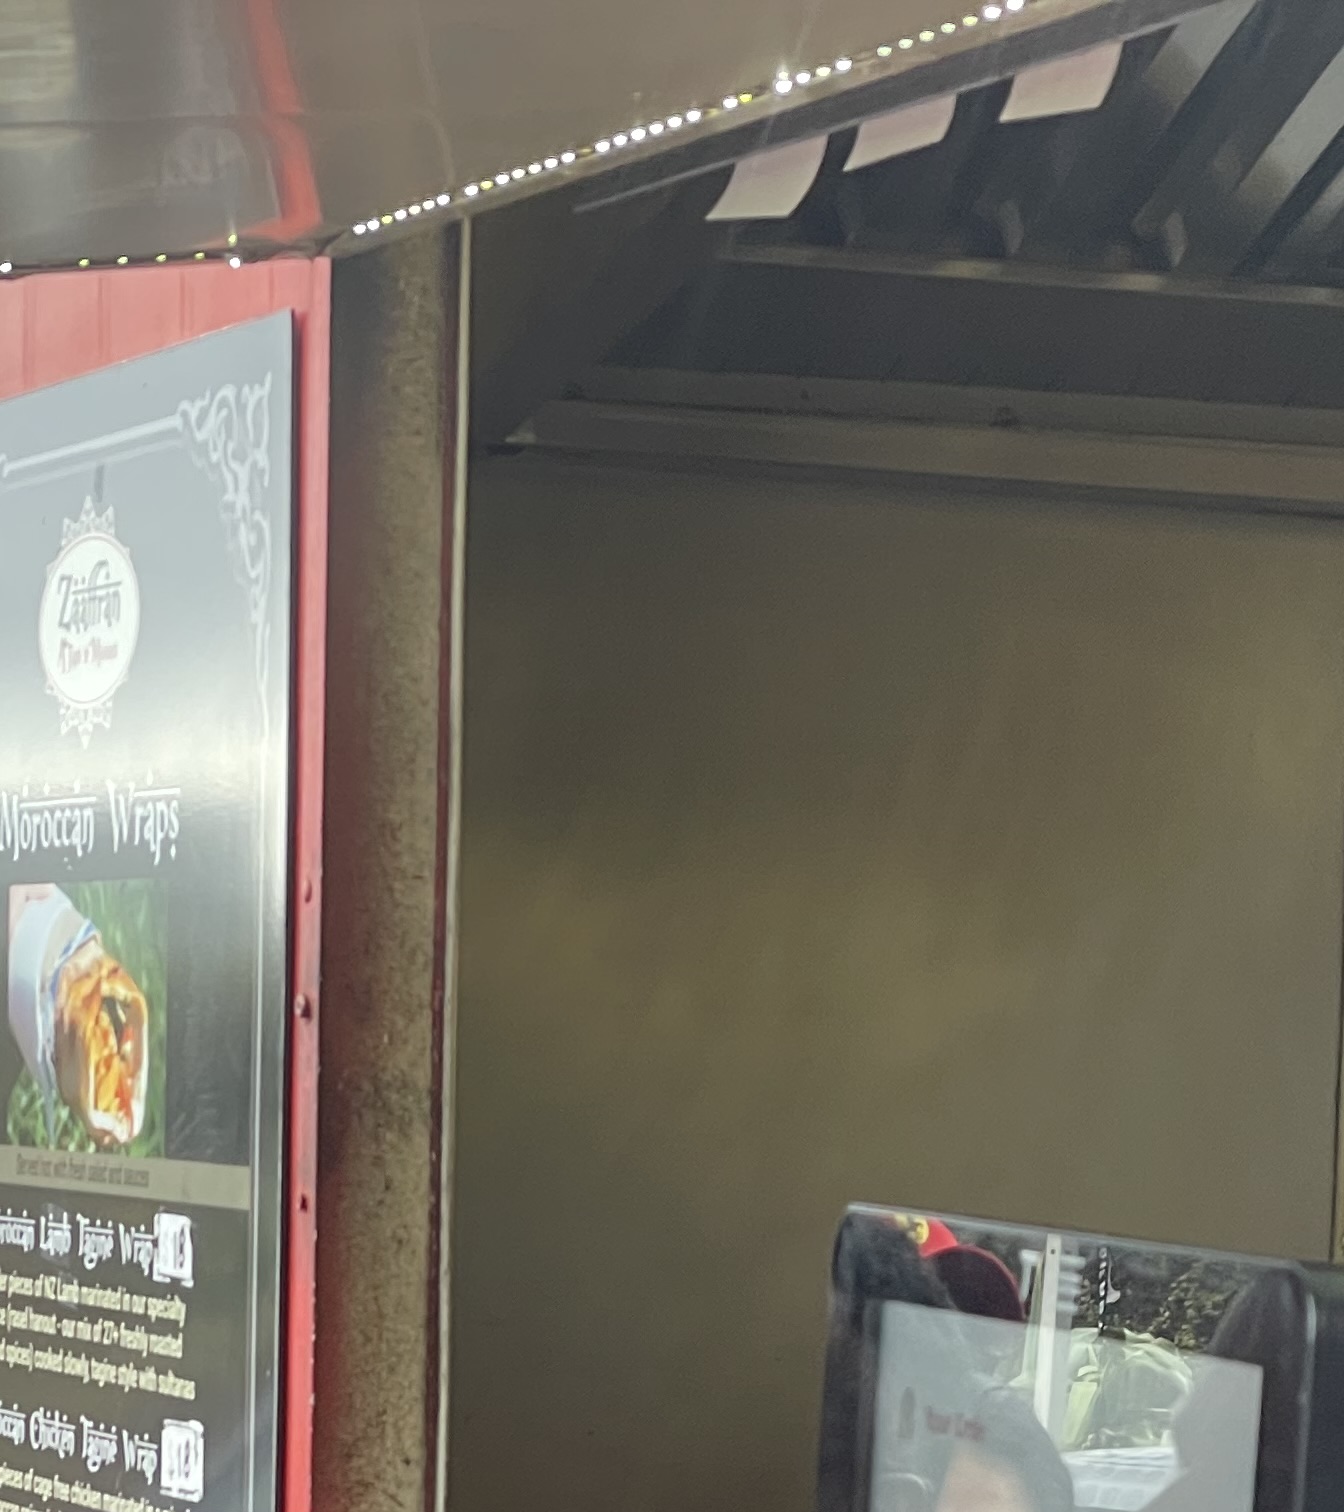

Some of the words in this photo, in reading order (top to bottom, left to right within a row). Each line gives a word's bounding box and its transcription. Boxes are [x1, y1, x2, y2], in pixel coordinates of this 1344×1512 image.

[0, 780, 96, 860] Moroccan
[105, 769, 180, 865] Wraps
[40, 1211, 72, 1256] Lamb
[76, 1213, 114, 1270] Tagine
[119, 1223, 155, 1277] Wrap
[8, 1270, 34, 1298] pieces
[34, 1273, 44, 1297] of
[44, 1275, 56, 1299] NZ
[57, 1277, 79, 1304] Lamb
[80, 1283, 122, 1311] marinated
[122, 1286, 130, 1312] in
[93, 1318, 102, 1343] of
[34, 1347, 63, 1373] cooked
[90, 1357, 116, 1388] tagine
[117, 1362, 138, 1393] style
[138, 1366, 157, 1391] with
[30, 1407, 76, 1459] Chicken
[80, 1414, 118, 1473] Tagine
[122, 1429, 158, 1485] Wrap
[24, 1468, 34, 1491] of
[34, 1475, 53, 1502] cage
[53, 1475, 70, 1502] free
[70, 1480, 101, 1509] chicken
